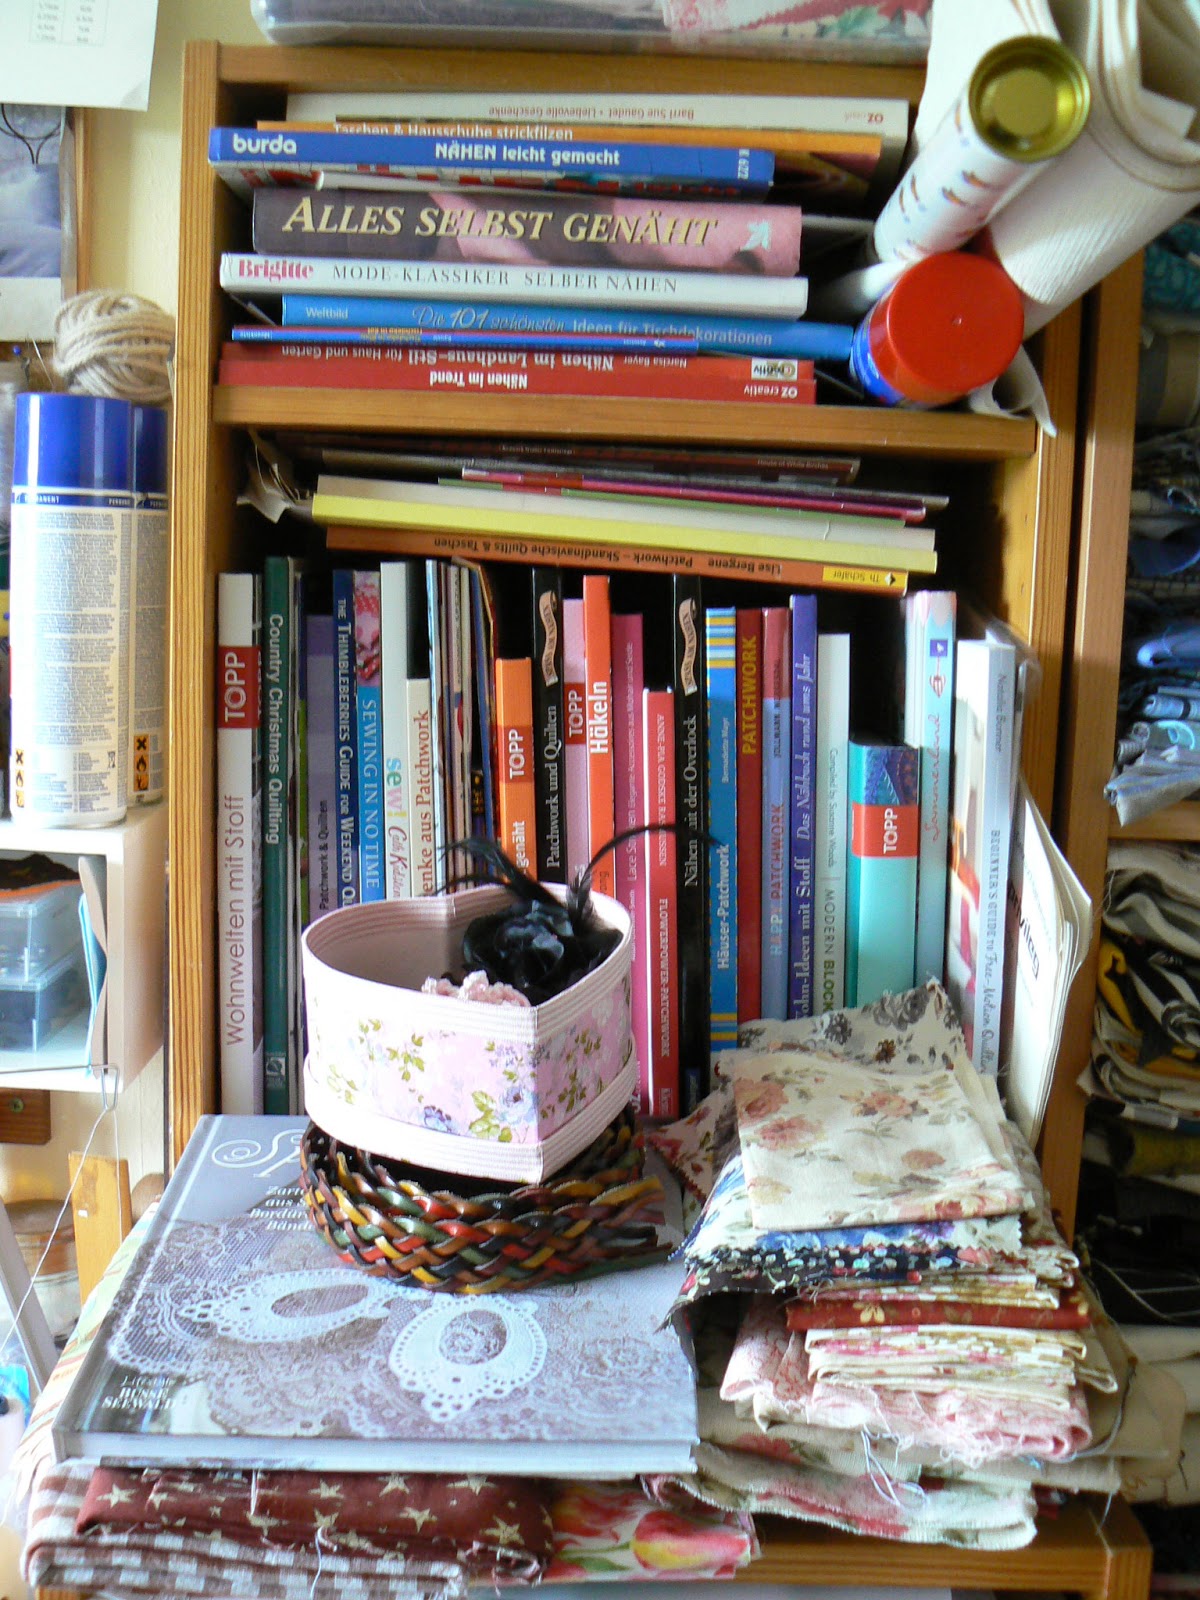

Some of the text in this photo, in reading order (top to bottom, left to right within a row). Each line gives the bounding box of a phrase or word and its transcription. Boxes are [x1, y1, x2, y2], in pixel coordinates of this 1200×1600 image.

[489, 105, 543, 119] Geschenke
[232, 133, 297, 155] burda
[435, 142, 621, 167] NÄHEN leicht gemacht
[282, 195, 719, 247] ALLES SELBST GENÄHT
[238, 258, 314, 283] Brigitte
[524, 271, 598, 290] SELBER
[606, 273, 678, 294] NÄHEN
[305, 306, 349, 320] Weltbild
[412, 306, 445, 327] Die
[448, 306, 489, 329] 101
[572, 317, 613, 334] Ideen
[618, 319, 639, 336] für
[643, 323, 773, 347] Tischdekorationen
[281, 345, 322, 360] Garten
[326, 346, 348, 359] und
[352, 346, 381, 361] Haus
[386, 347, 403, 362] für
[408, 350, 528, 368] Landhaus-Stil
[533, 353, 555, 370] im
[561, 353, 614, 371] Nähen
[623, 354, 650, 368] Bayer
[430, 370, 465, 387] Trend
[483, 372, 528, 390] Nähen
[743, 384, 798, 399] OZ creativ
[433, 536, 782, 576] Lise Bergene Patchwork Skandinavische Quilts & Taschen
[337, 598, 347, 619] THE
[224, 651, 247, 723] TOPP
[337, 622, 352, 742] THIMBLEBERRIES
[741, 634, 758, 757] PATCHWORK
[265, 613, 284, 845] Country Christmas Quilting
[567, 689, 584, 738] TOPP
[587, 680, 609, 755] Häkeln
[413, 709, 433, 807] Patchwork
[508, 728, 527, 780] TOPP
[656, 713, 666, 764] ANNE-PIA
[682, 713, 698, 781] Overlock
[794, 654, 813, 841] Das Nähbuch rund ums Jahr
[339, 745, 354, 791] GUIDE
[543, 705, 563, 869] Patchwork und Quilten
[828, 749, 839, 788] Compiled
[340, 794, 350, 814] FOR
[362, 699, 381, 889] SEWING IN NO TIME
[683, 784, 698, 808] der
[318, 842, 329, 851] &
[420, 811, 434, 842] aus
[883, 807, 898, 854] TOPP
[340, 816, 355, 882] WEEKEND
[627, 855, 638, 882] Lace
[684, 839, 698, 887] Nähen
[827, 837, 838, 868] Woods
[988, 829, 1001, 900] BEGINNER'S
[319, 853, 330, 911] Patchwork
[770, 802, 785, 957] HAPPY PATCHWORK
[794, 856, 811, 898] Stoff
[224, 795, 246, 1046] Wohnwelten mit Stoff
[717, 844, 730, 970] Häuser-Patchwork
[797, 902, 811, 930] mit
[824, 888, 836, 955] MODERN
[986, 901, 998, 937] GUIDE
[659, 898, 670, 1058] FLOWERPOWER-PATCHWORK
[119, 1387, 169, 1399] BUSSE
